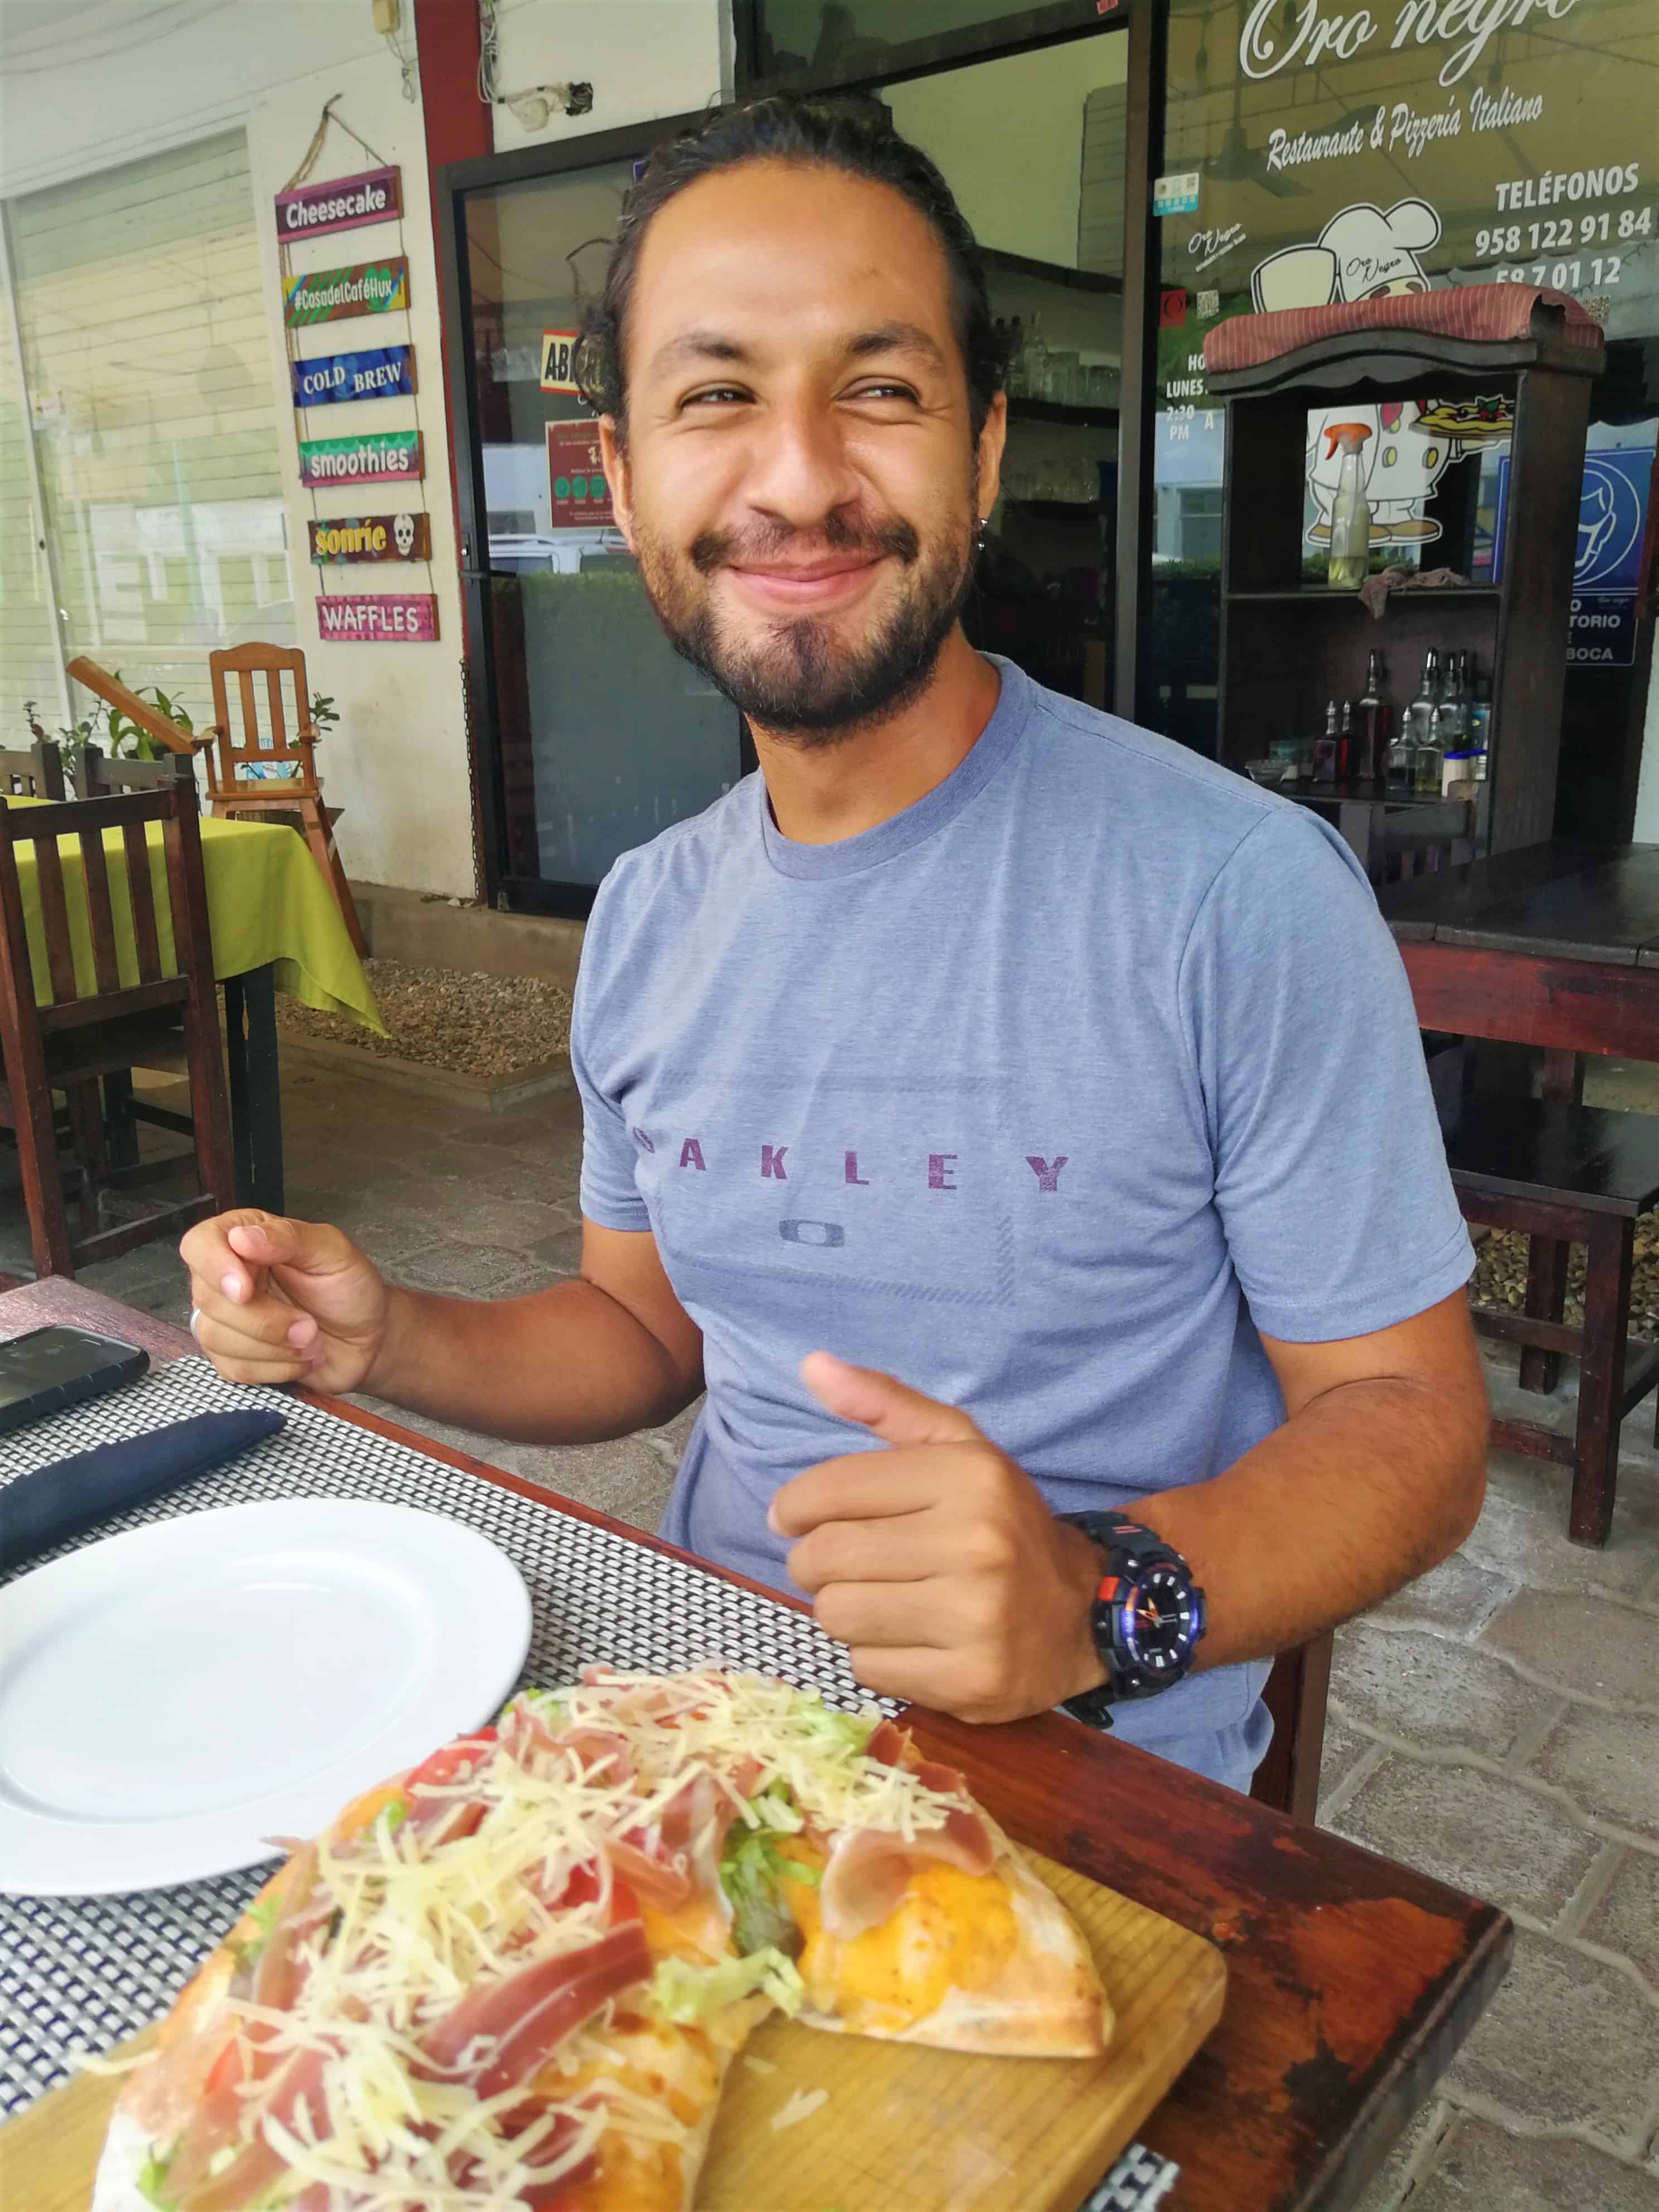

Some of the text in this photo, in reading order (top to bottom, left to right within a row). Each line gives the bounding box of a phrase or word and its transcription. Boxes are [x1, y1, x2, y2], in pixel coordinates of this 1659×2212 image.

[1239, 0, 1377, 79] Oro
[1267, 86, 1544, 172] Restaurante & Pizzería Italiano
[1495, 162, 1639, 212] TELÉFONOS
[286, 185, 386, 228] Cheesecake
[1475, 206, 1652, 258] 958 122 91 84
[1532, 265, 1547, 287] 7
[1551, 260, 1581, 290] 01
[1590, 256, 1621, 286] 12
[303, 361, 401, 395] COLD BREW
[1170, 425, 1189, 440] PM
[311, 442, 409, 478] smoothies
[315, 518, 387, 555] sonríe
[321, 604, 419, 633] WAFFLES
